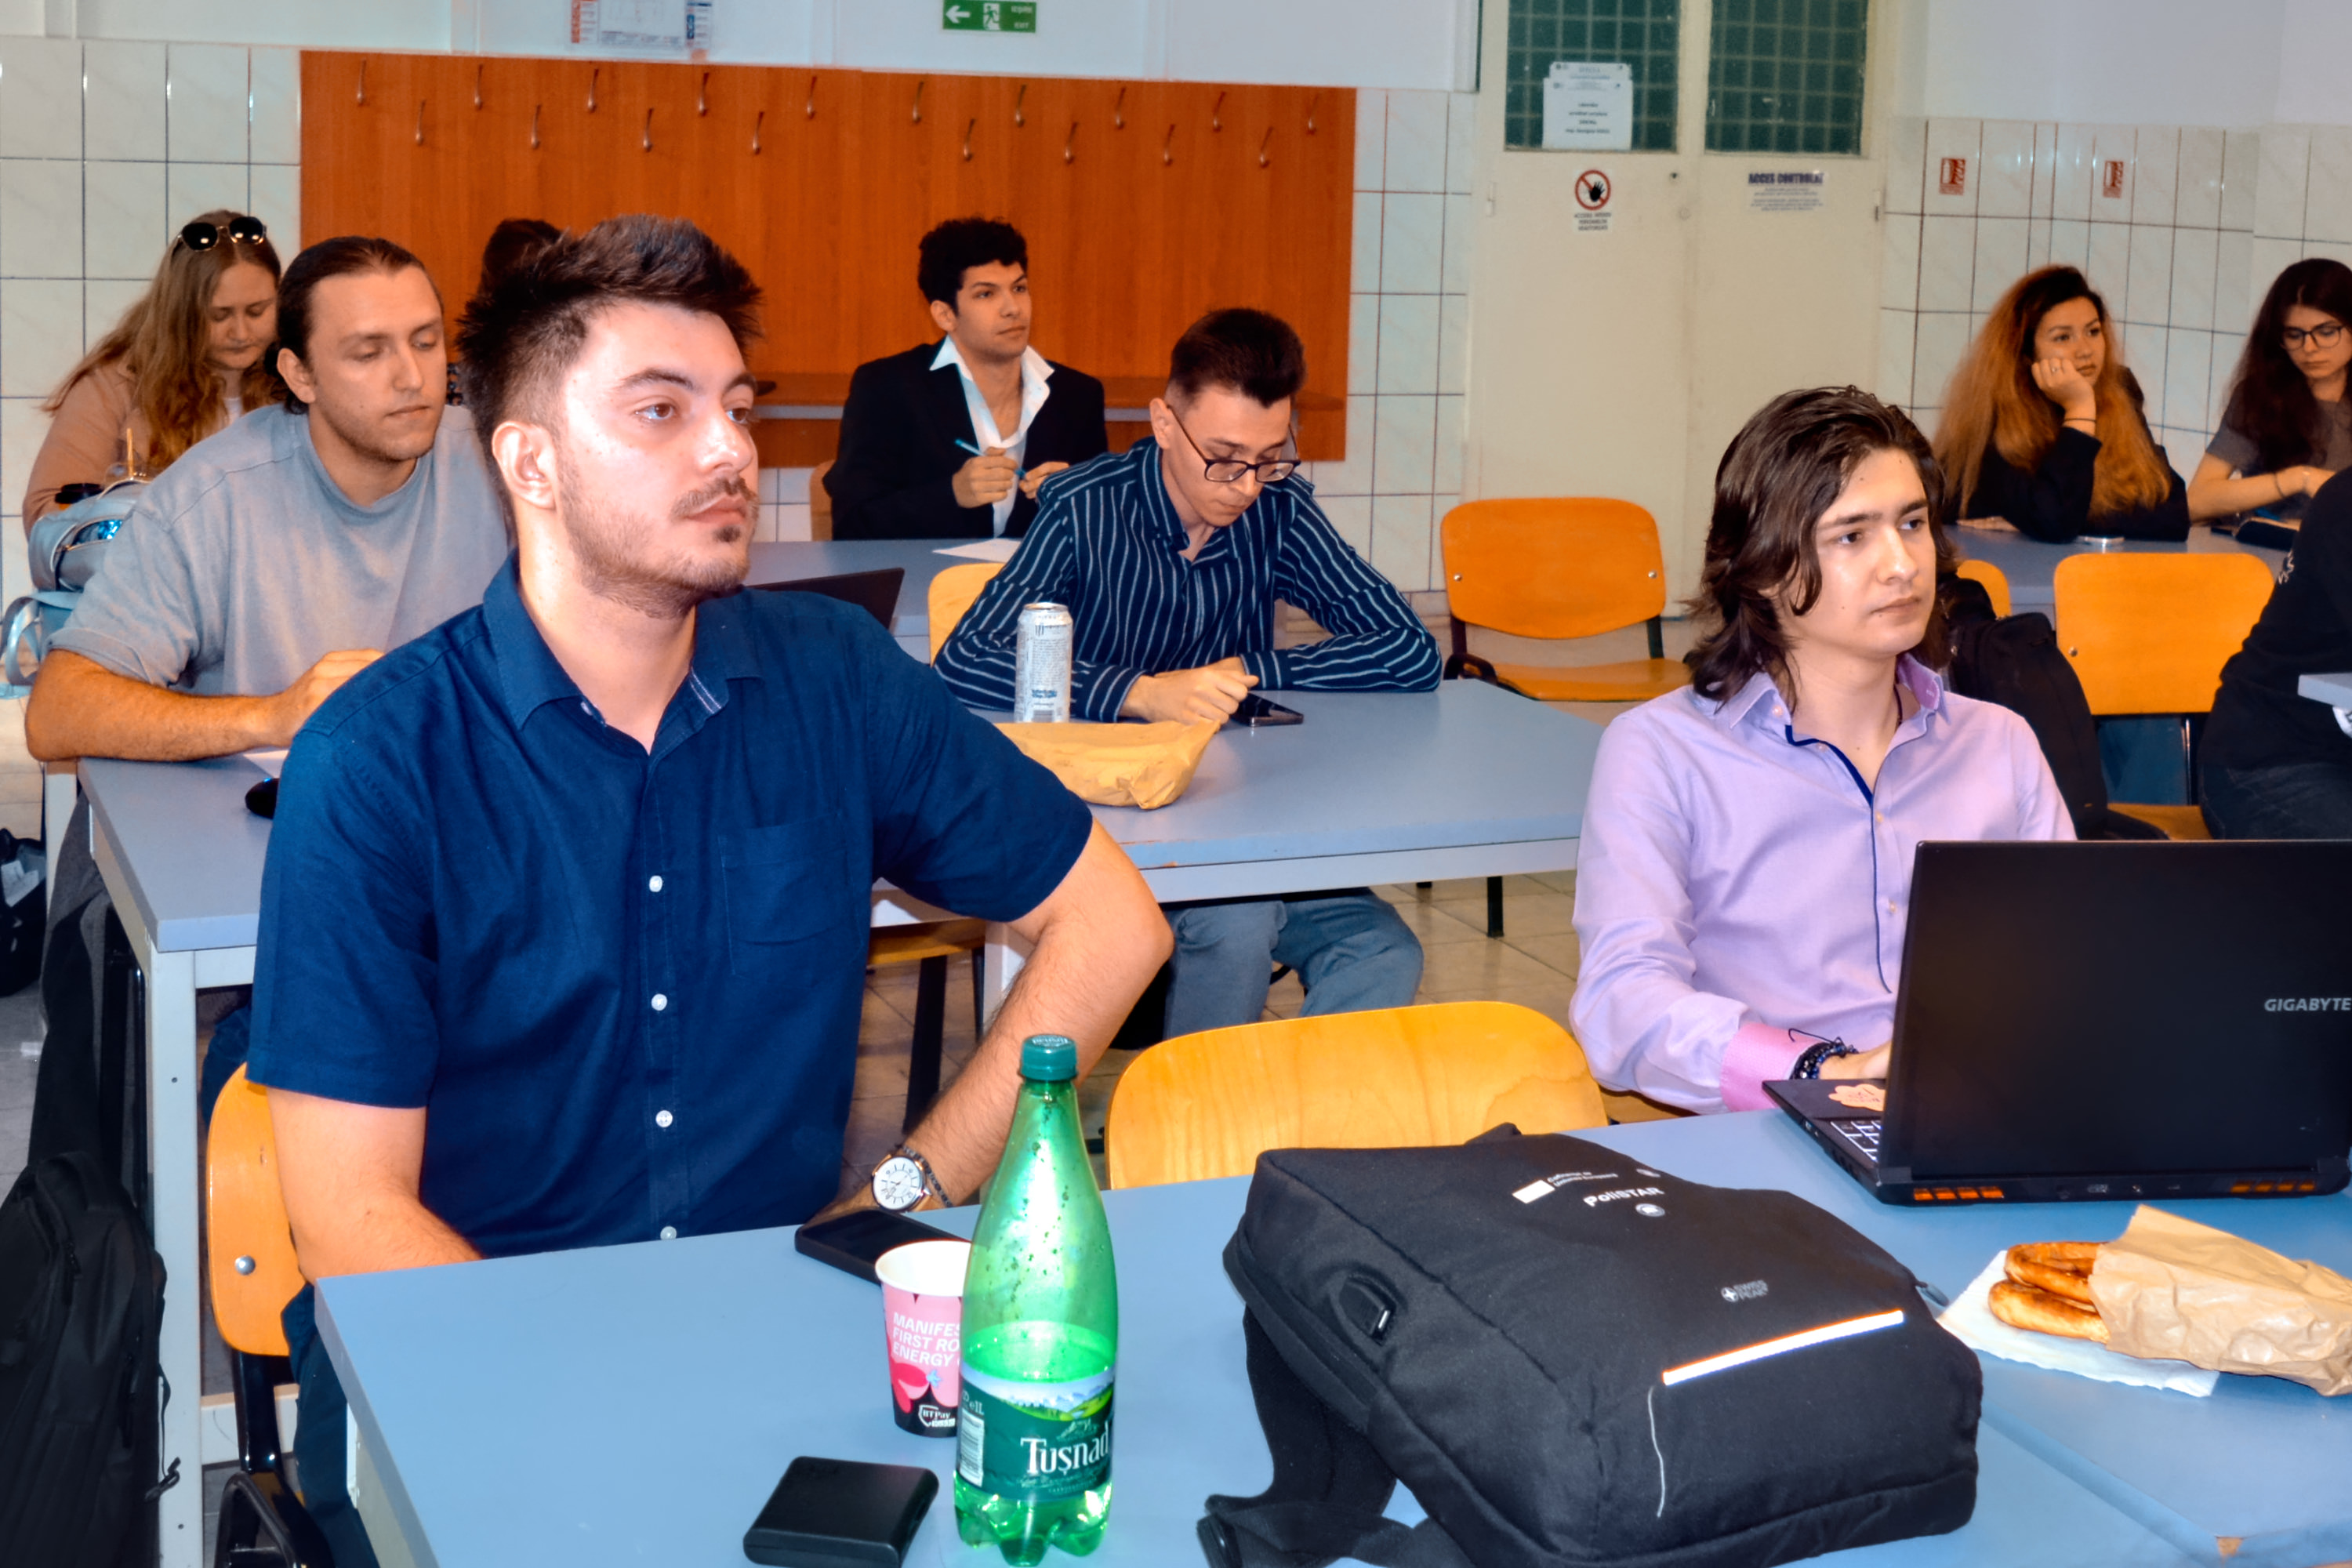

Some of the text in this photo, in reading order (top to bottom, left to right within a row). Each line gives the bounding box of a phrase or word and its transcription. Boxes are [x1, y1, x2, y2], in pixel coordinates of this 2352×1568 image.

[2264, 997, 2352, 1011] GIGABYTE
[894, 1326, 933, 1350] FIRST
[894, 1341, 954, 1367] ENERGY
